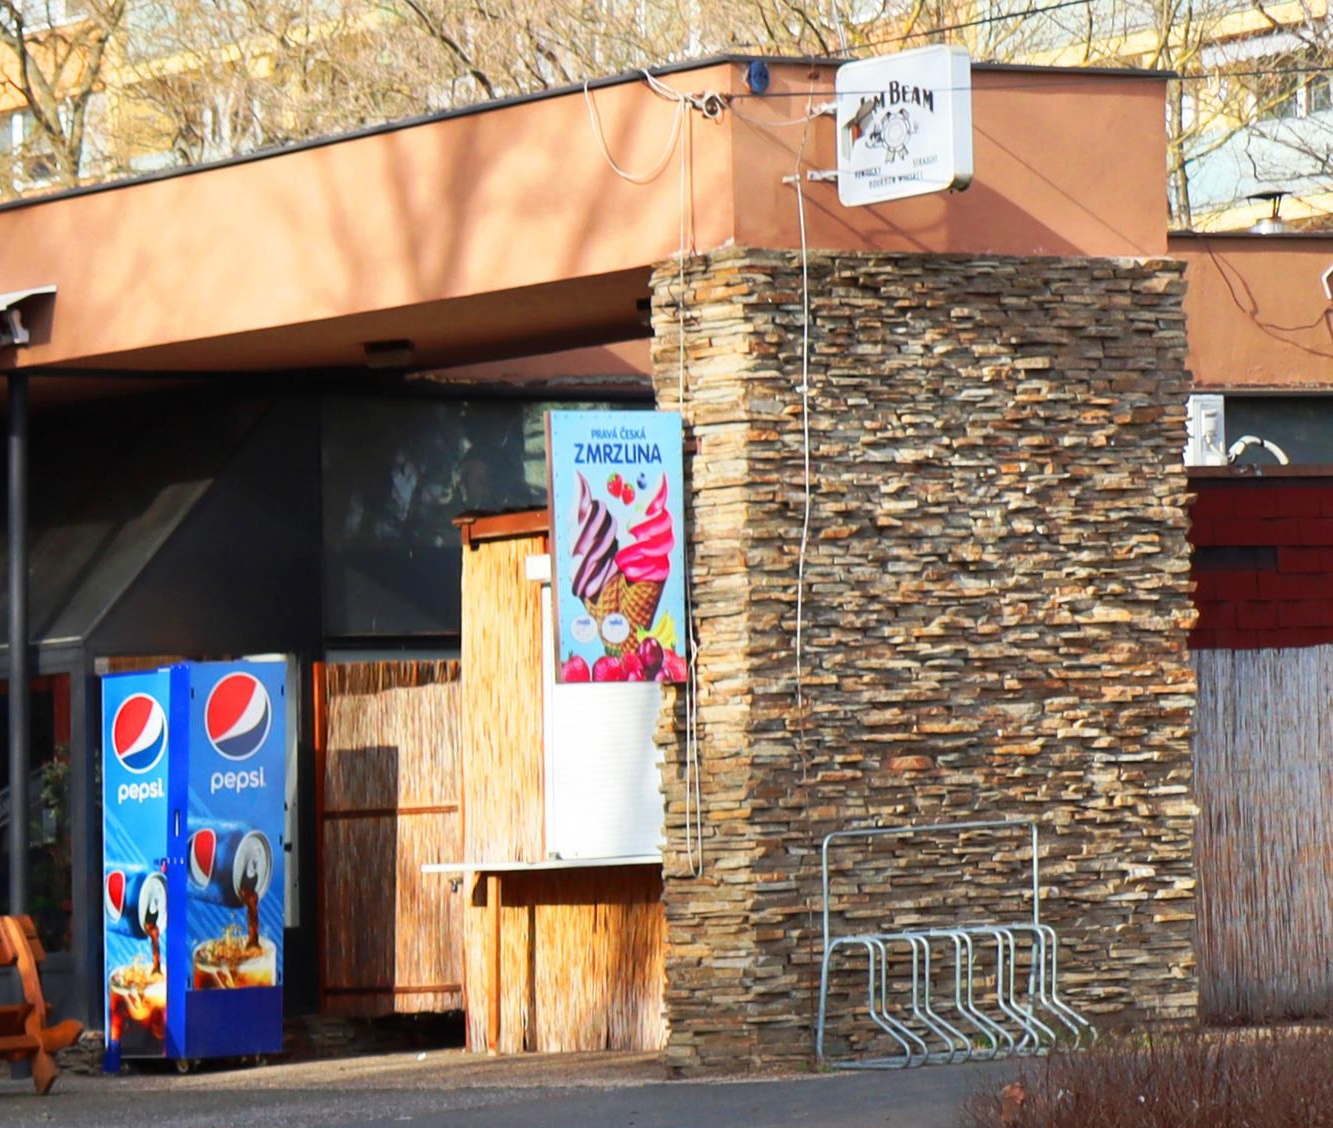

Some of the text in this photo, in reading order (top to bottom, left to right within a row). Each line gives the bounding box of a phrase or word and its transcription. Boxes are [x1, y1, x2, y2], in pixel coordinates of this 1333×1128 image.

[889, 80, 934, 113] BEAM
[591, 427, 646, 440] PRAVÁ ČESKÁ
[574, 443, 662, 464] ZMRZLINA
[118, 777, 164, 805] pepsi
[210, 766, 265, 795] pepsi
